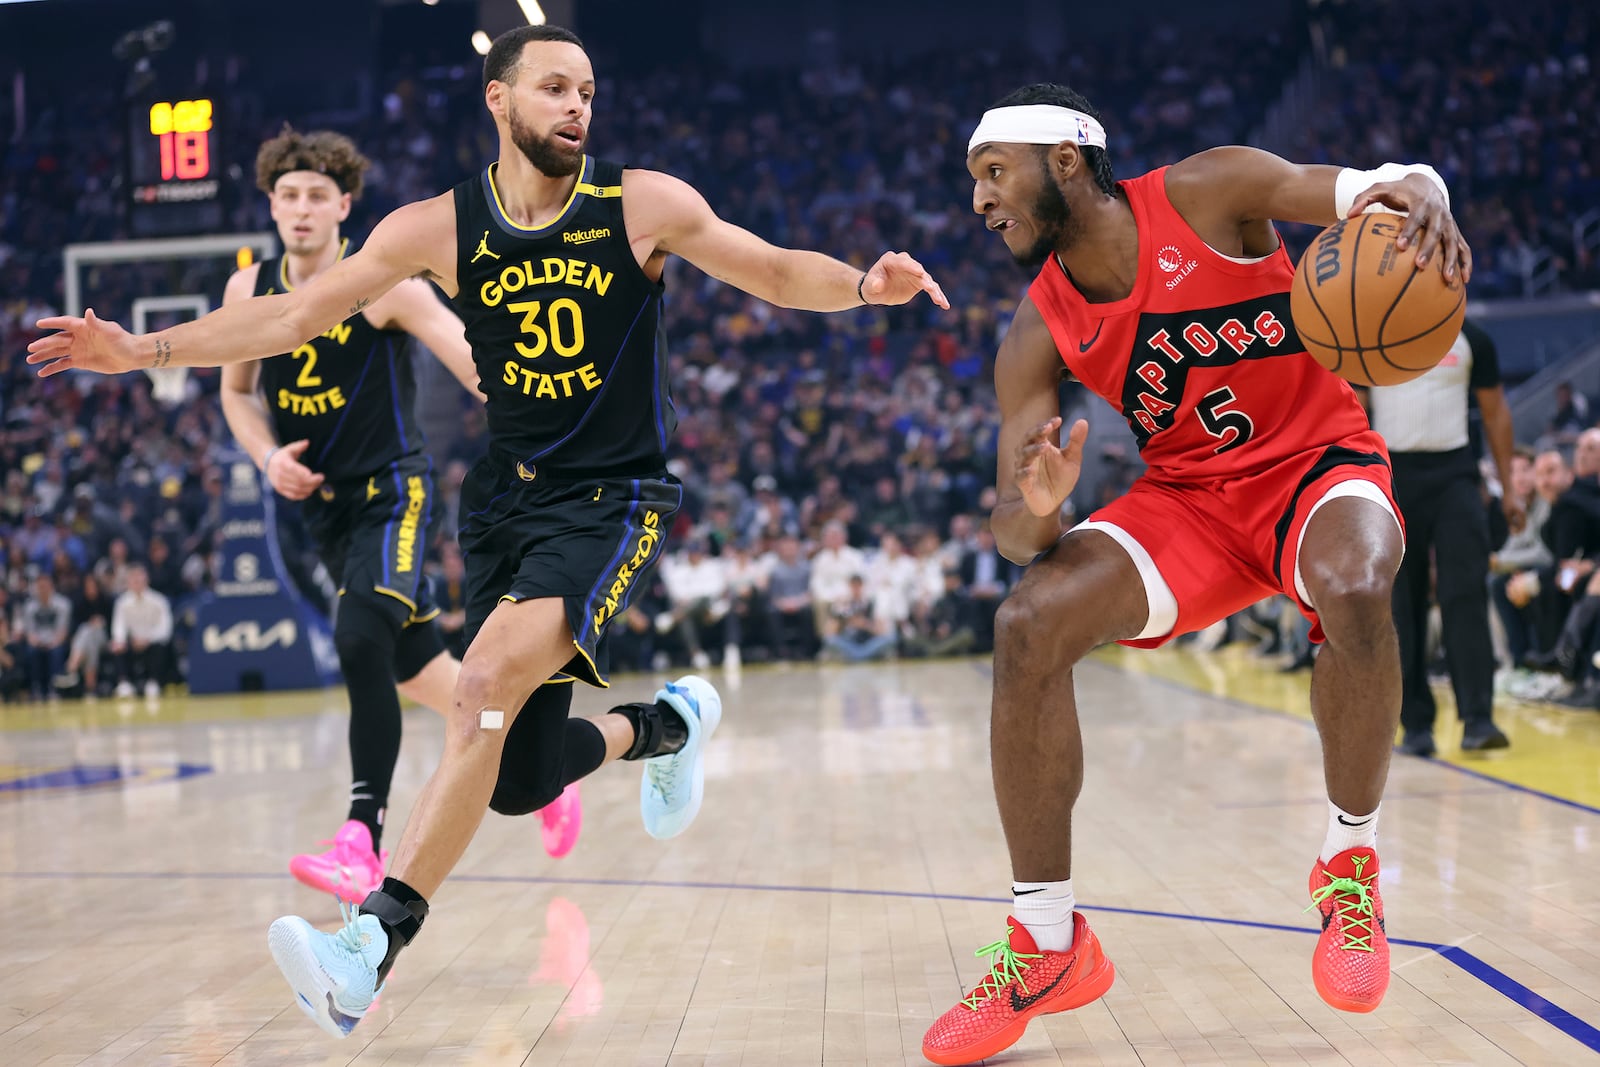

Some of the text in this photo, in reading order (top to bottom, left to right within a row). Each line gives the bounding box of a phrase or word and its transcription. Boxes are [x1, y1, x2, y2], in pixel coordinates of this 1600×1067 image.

[160, 131, 210, 181] 18
[594, 187, 604, 197] 16
[563, 228, 611, 245] Rakuten
[480, 257, 614, 307] GOLDEN
[1165, 259, 1199, 291] Sun Life
[506, 297, 585, 359] 30
[292, 343, 323, 388] 2
[502, 360, 603, 399] STATE
[1133, 310, 1286, 434] RAPTORS
[278, 386, 347, 416] STATE
[1194, 385, 1255, 454] 5
